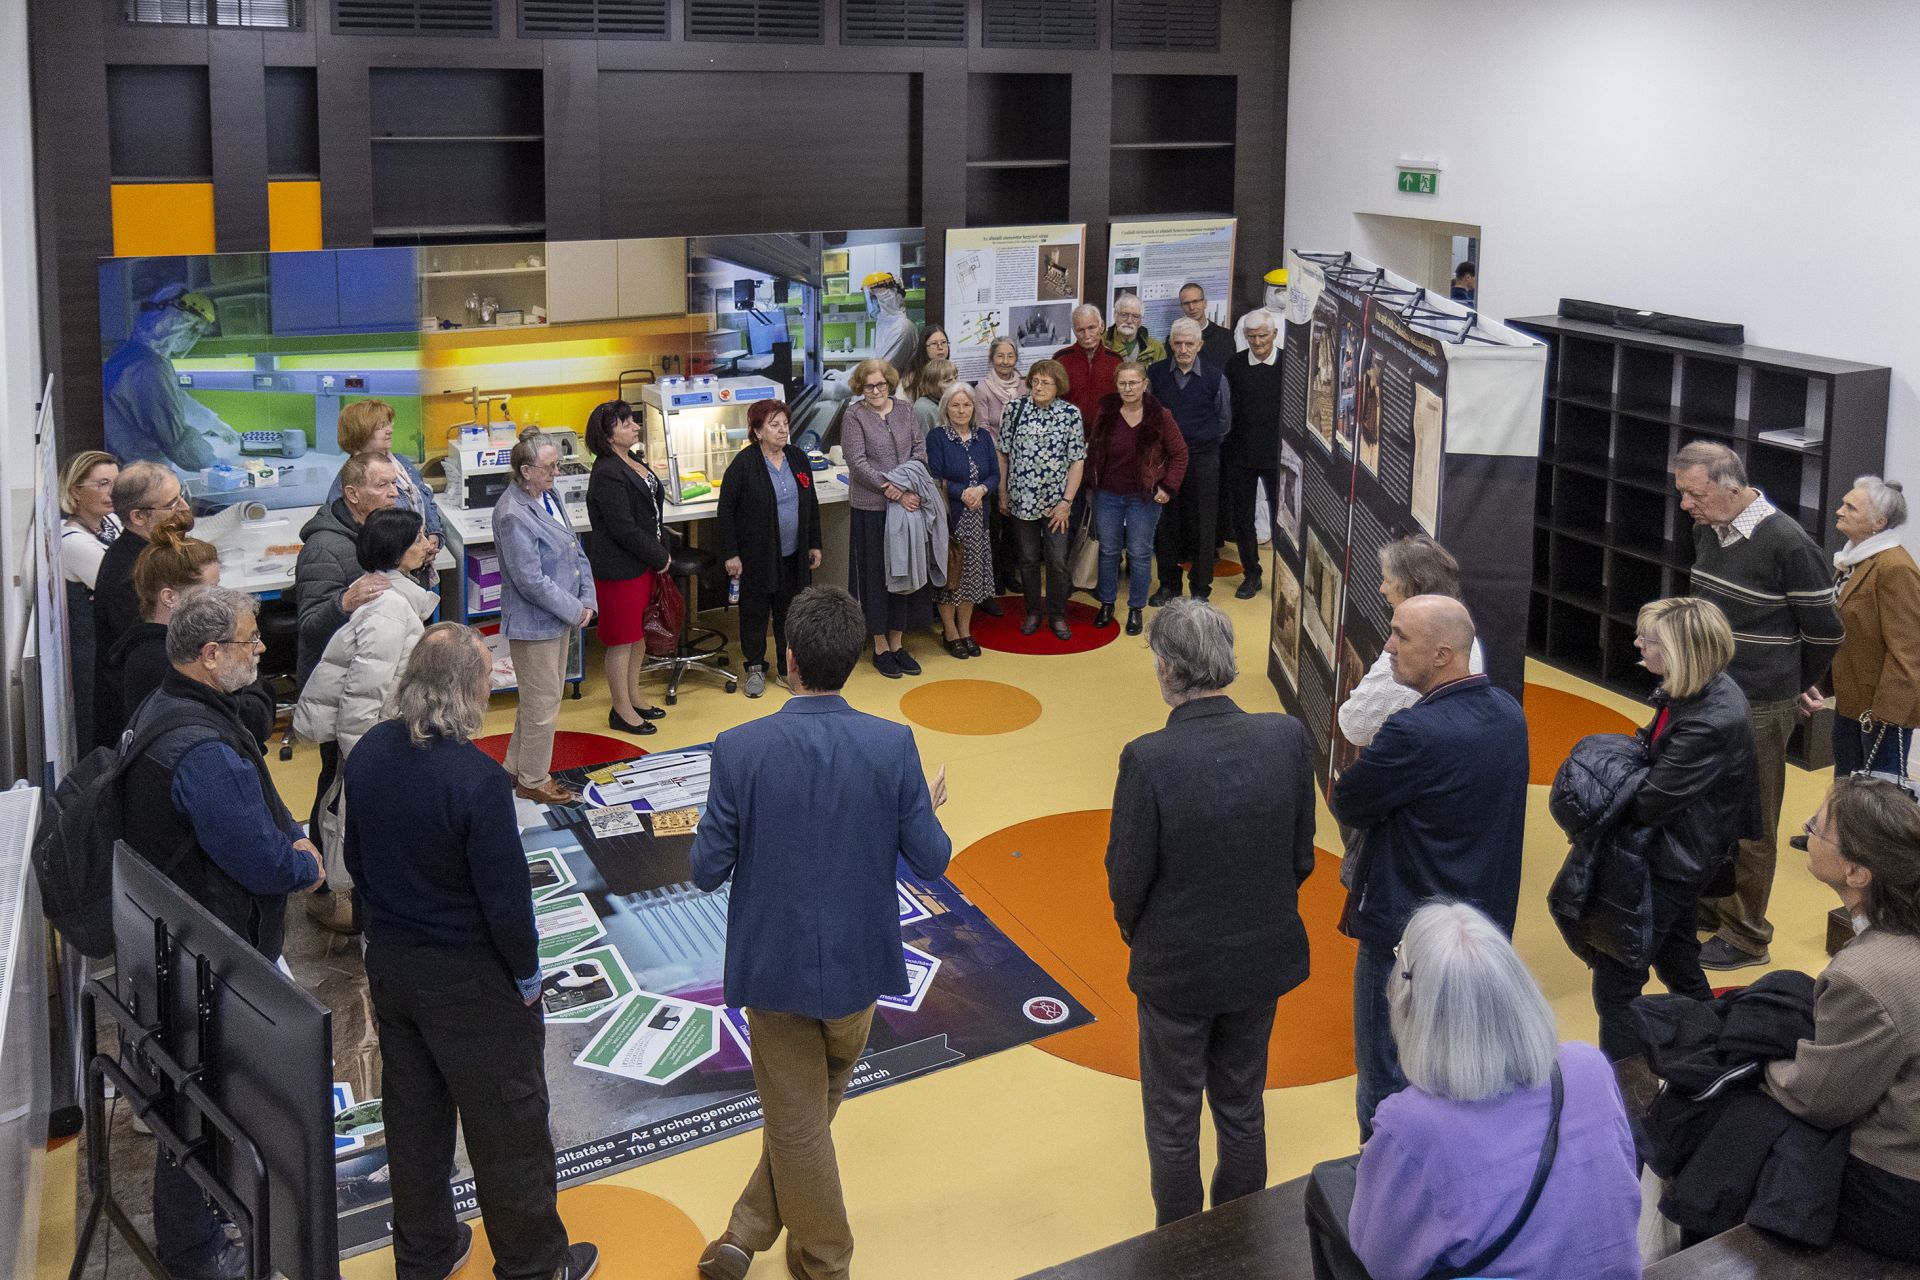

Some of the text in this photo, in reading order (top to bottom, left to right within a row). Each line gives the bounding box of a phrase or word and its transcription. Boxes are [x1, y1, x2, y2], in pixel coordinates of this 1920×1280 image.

[452, 1181, 477, 1196] DN
[556, 1141, 615, 1165] altatása
[631, 1130, 651, 1142] Az
[652, 1096, 761, 1135] archeogenomik
[556, 1156, 612, 1179] enomes
[627, 1142, 656, 1156] The
[659, 1128, 699, 1146] steps
[702, 1121, 716, 1133] of
[719, 1108, 764, 1127] archae
[847, 1069, 890, 1087] search
